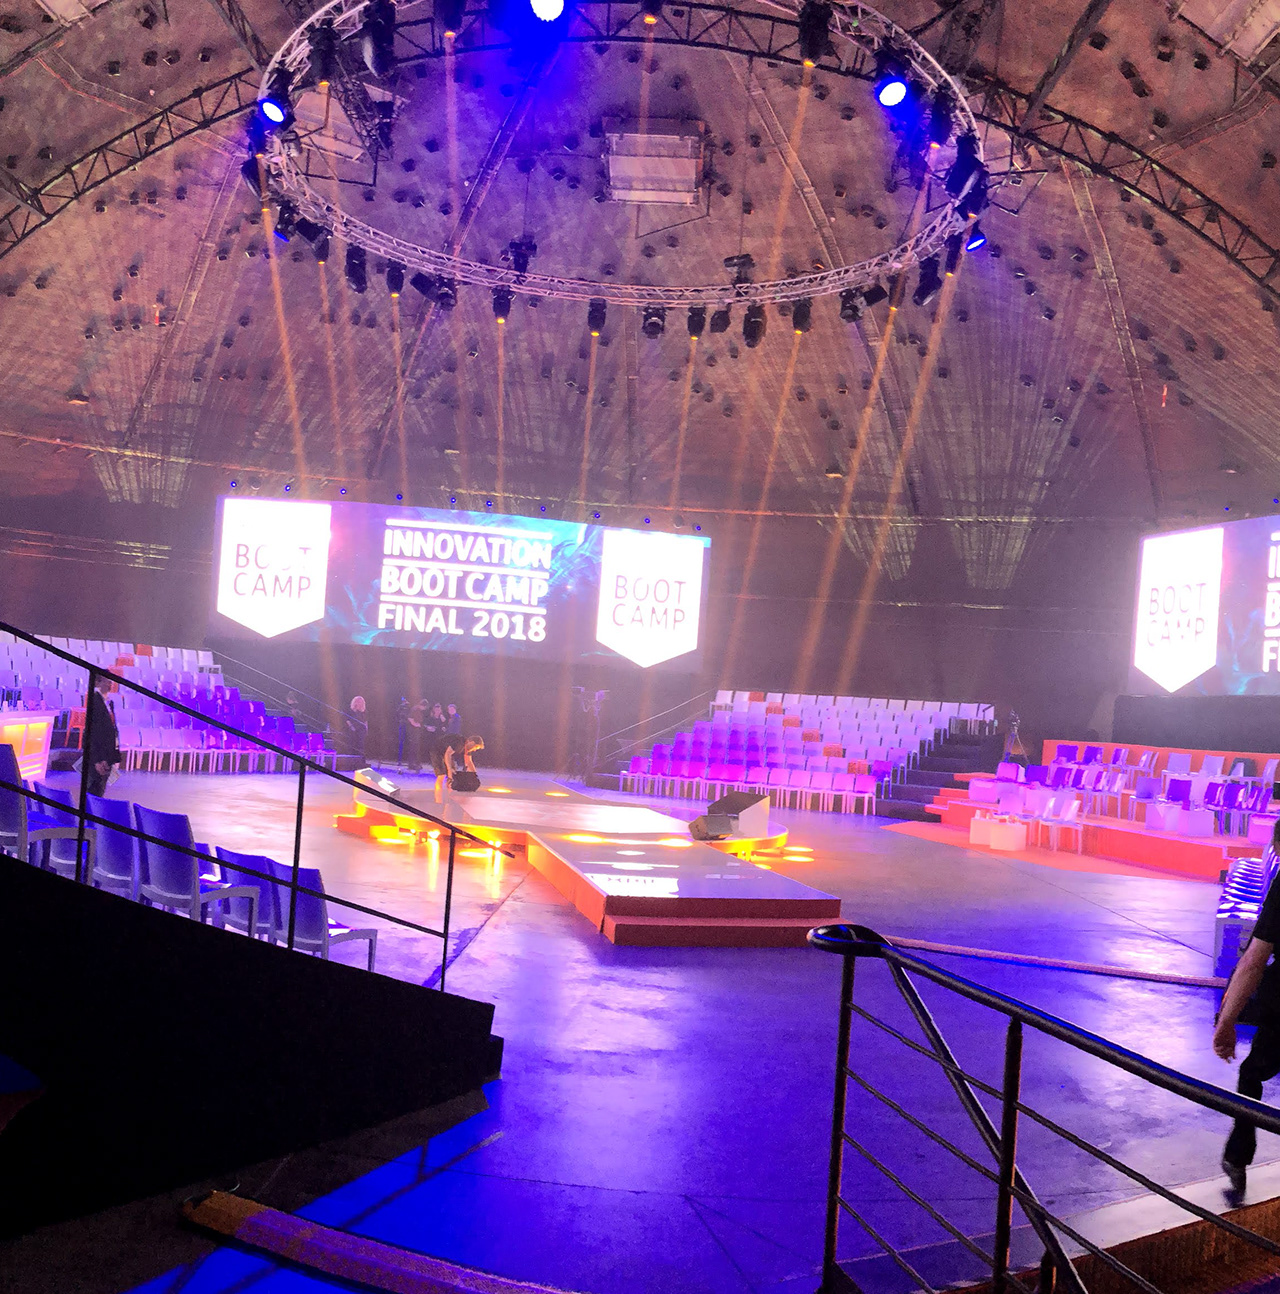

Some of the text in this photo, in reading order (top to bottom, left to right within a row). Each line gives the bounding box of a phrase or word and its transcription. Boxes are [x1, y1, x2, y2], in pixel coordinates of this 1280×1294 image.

[235, 543, 312, 571] BOT
[384, 529, 552, 569] INNOVATION
[233, 572, 311, 599] CAMP
[615, 574, 687, 605] BOOT
[377, 603, 546, 642] FINAL 2018
[612, 603, 686, 630] CAMP
